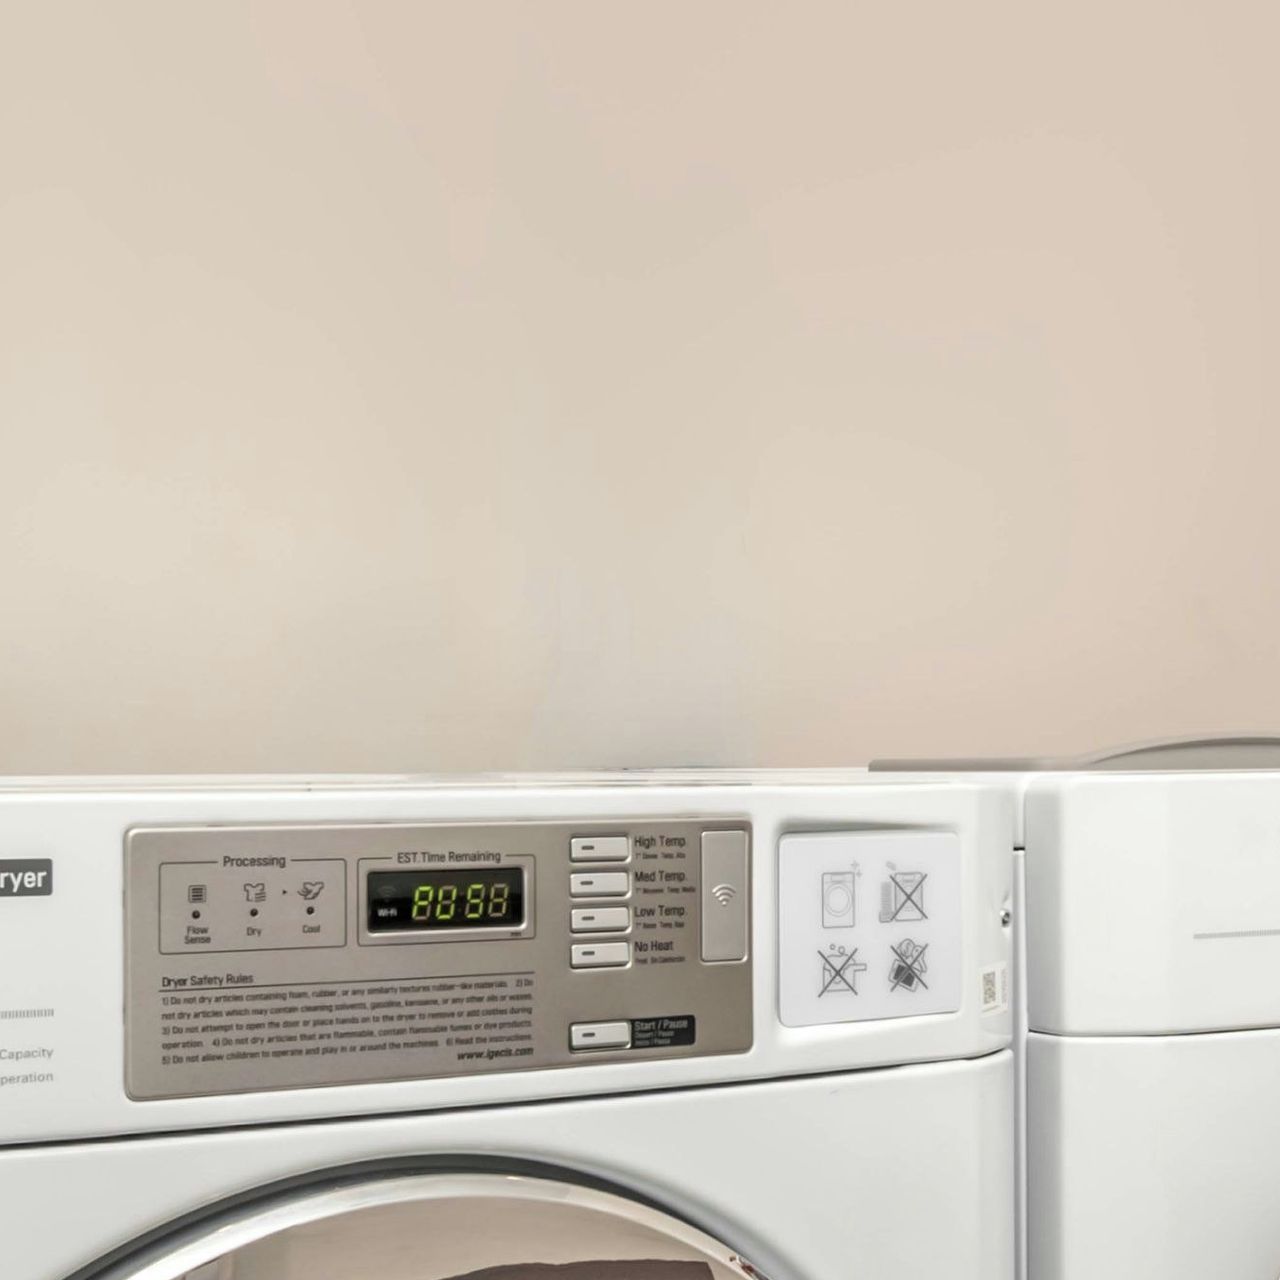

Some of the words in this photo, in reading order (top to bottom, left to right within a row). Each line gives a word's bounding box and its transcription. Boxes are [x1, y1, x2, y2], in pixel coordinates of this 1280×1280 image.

[635, 836, 656, 849] High
[223, 856, 286, 868] Processing
[421, 851, 446, 863] Time
[448, 851, 501, 864] Remaining
[635, 871, 656, 882] Med
[635, 906, 655, 918] Low
[246, 926, 262, 937] Dry
[184, 935, 211, 945] Sense
[635, 941, 649, 952] No
[651, 940, 674, 951] Heat
[162, 976, 188, 989] Dryer
[190, 975, 224, 987] Safety
[226, 973, 254, 985] Rules
[634, 1021, 656, 1031] Start
[663, 1018, 688, 1029] Pause
